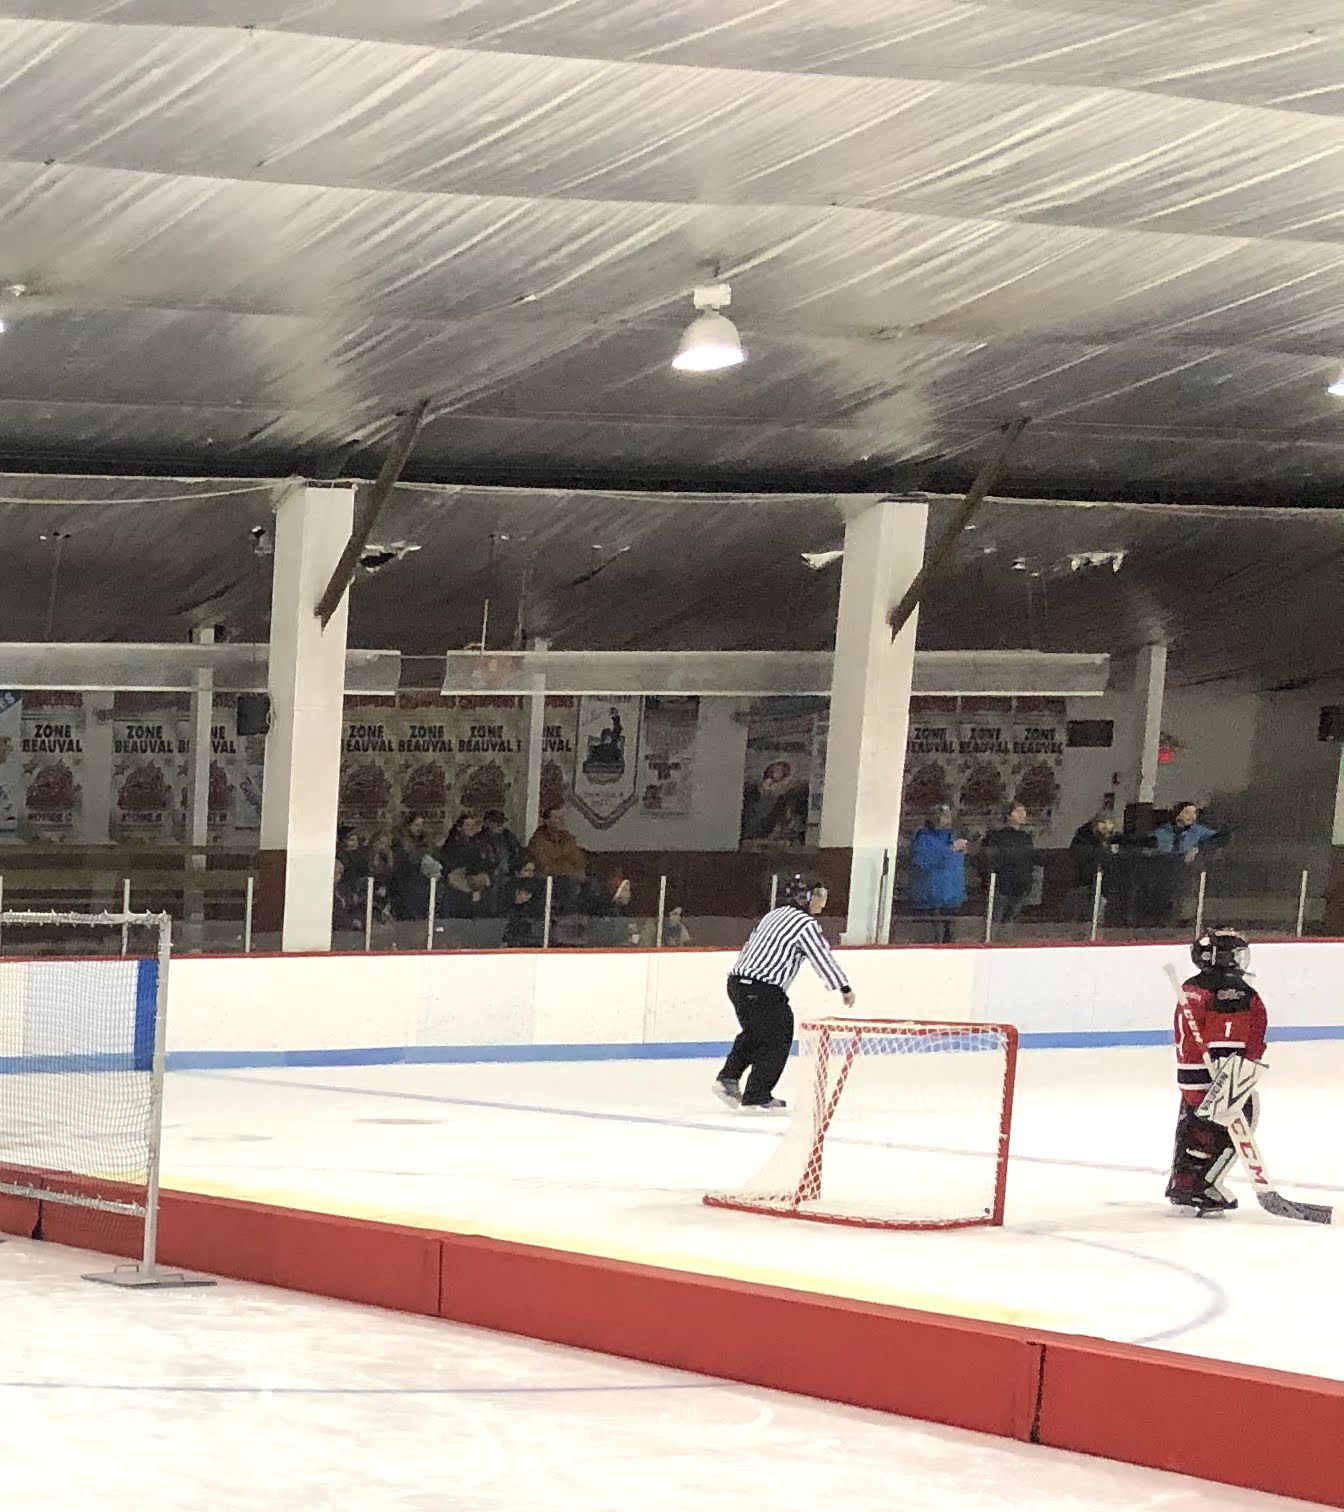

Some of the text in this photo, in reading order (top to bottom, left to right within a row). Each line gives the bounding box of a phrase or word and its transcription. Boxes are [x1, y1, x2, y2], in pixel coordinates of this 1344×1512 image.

[34, 724, 72, 739] ZONE
[126, 725, 163, 739] ZONE
[349, 724, 385, 739] ZONE
[409, 724, 445, 739] ZONE
[469, 725, 504, 739] ZONE
[22, 739, 83, 753] BEAUVAL
[115, 740, 174, 754] BEAUVAL
[341, 739, 394, 752] EAUVAL
[398, 739, 454, 752] BEAUVAL
[458, 739, 514, 752] BEAUVAL
[909, 741, 955, 754] EAUVAL
[1224, 1021, 1233, 1038] 1
[1231, 1117, 1269, 1186] CCM
